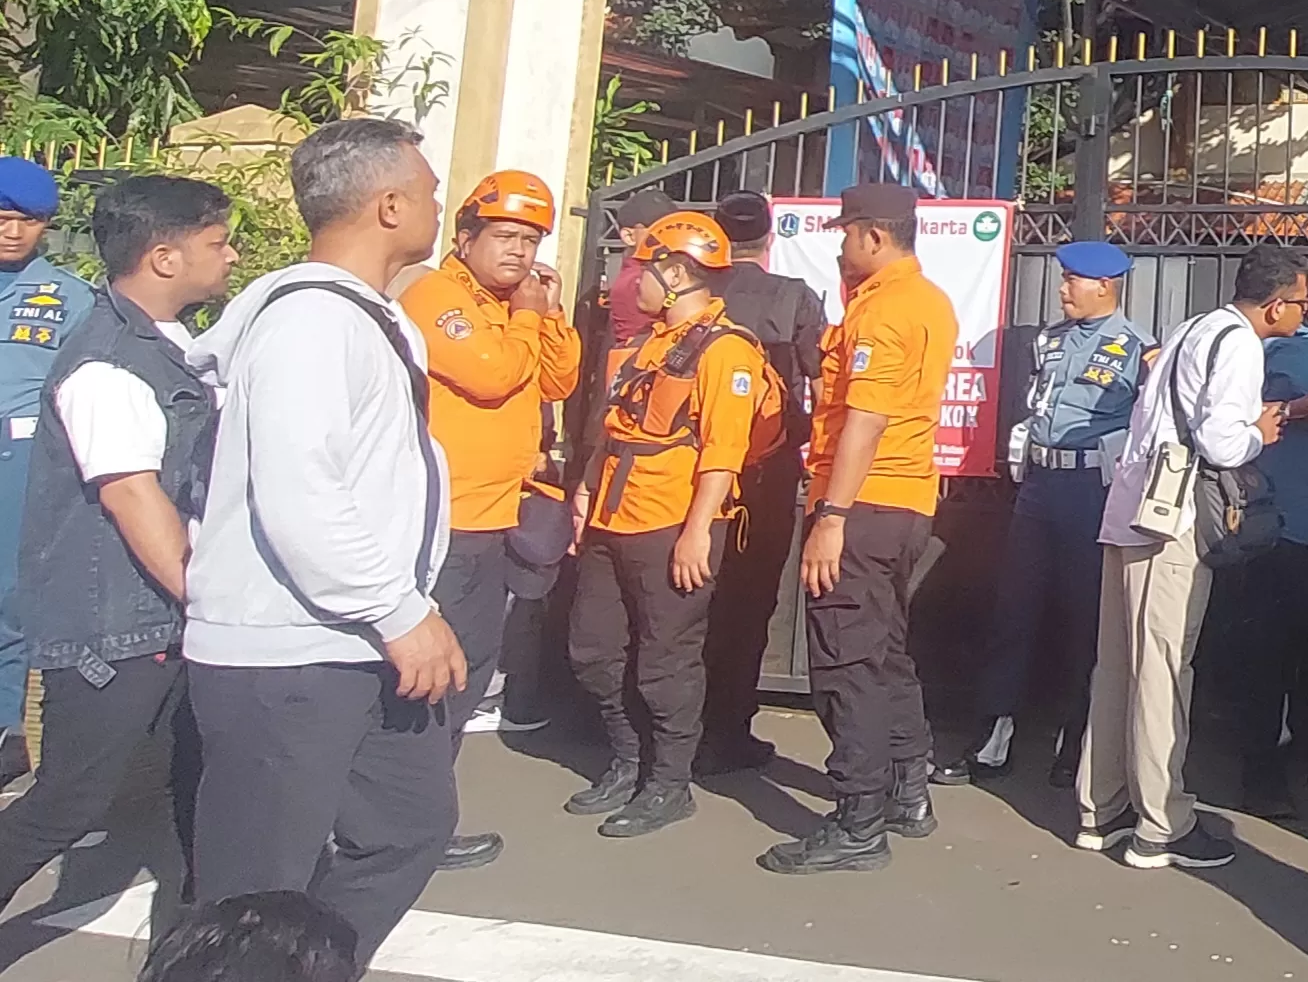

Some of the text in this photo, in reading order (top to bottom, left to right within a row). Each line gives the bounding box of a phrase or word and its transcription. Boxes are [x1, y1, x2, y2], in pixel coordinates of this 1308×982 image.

[920, 217, 967, 235] karta
[14, 307, 63, 322] TNI AL
[955, 341, 975, 360] ok
[1110, 359, 1123, 371] AL
[942, 372, 987, 402] REA
